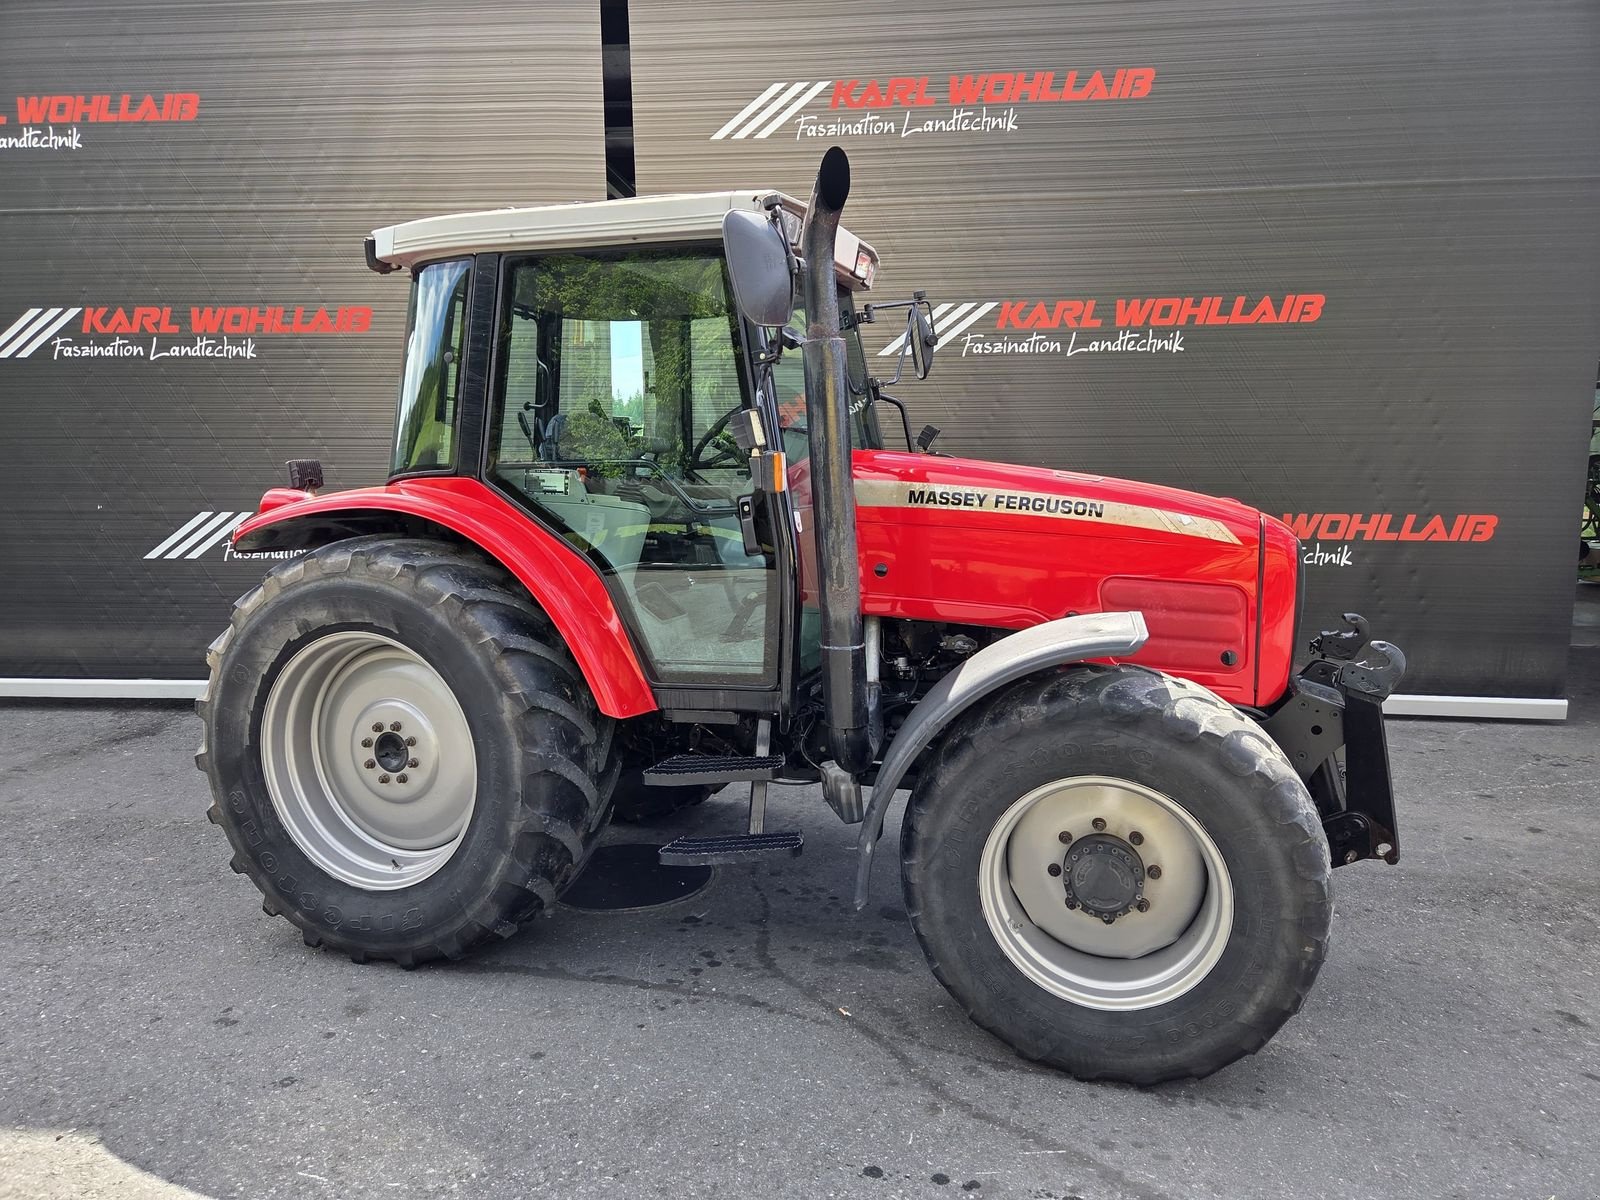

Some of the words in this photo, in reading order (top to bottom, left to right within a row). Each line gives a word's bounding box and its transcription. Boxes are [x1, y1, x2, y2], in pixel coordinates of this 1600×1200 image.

[831, 77, 936, 109] KARL
[0, 126, 83, 149] andtechnik
[795, 114, 895, 141] Faszination
[901, 107, 1019, 138] Landtechnik
[82, 307, 180, 334] KARL
[996, 300, 1102, 329] KARL
[51, 337, 144, 360] Faszination
[150, 336, 257, 360] Landtechnik
[961, 331, 1061, 358] Faszination
[1067, 329, 1185, 357] Landtechnik
[907, 489, 988, 508] MASSEY
[993, 494, 1105, 519] FERGUSON
